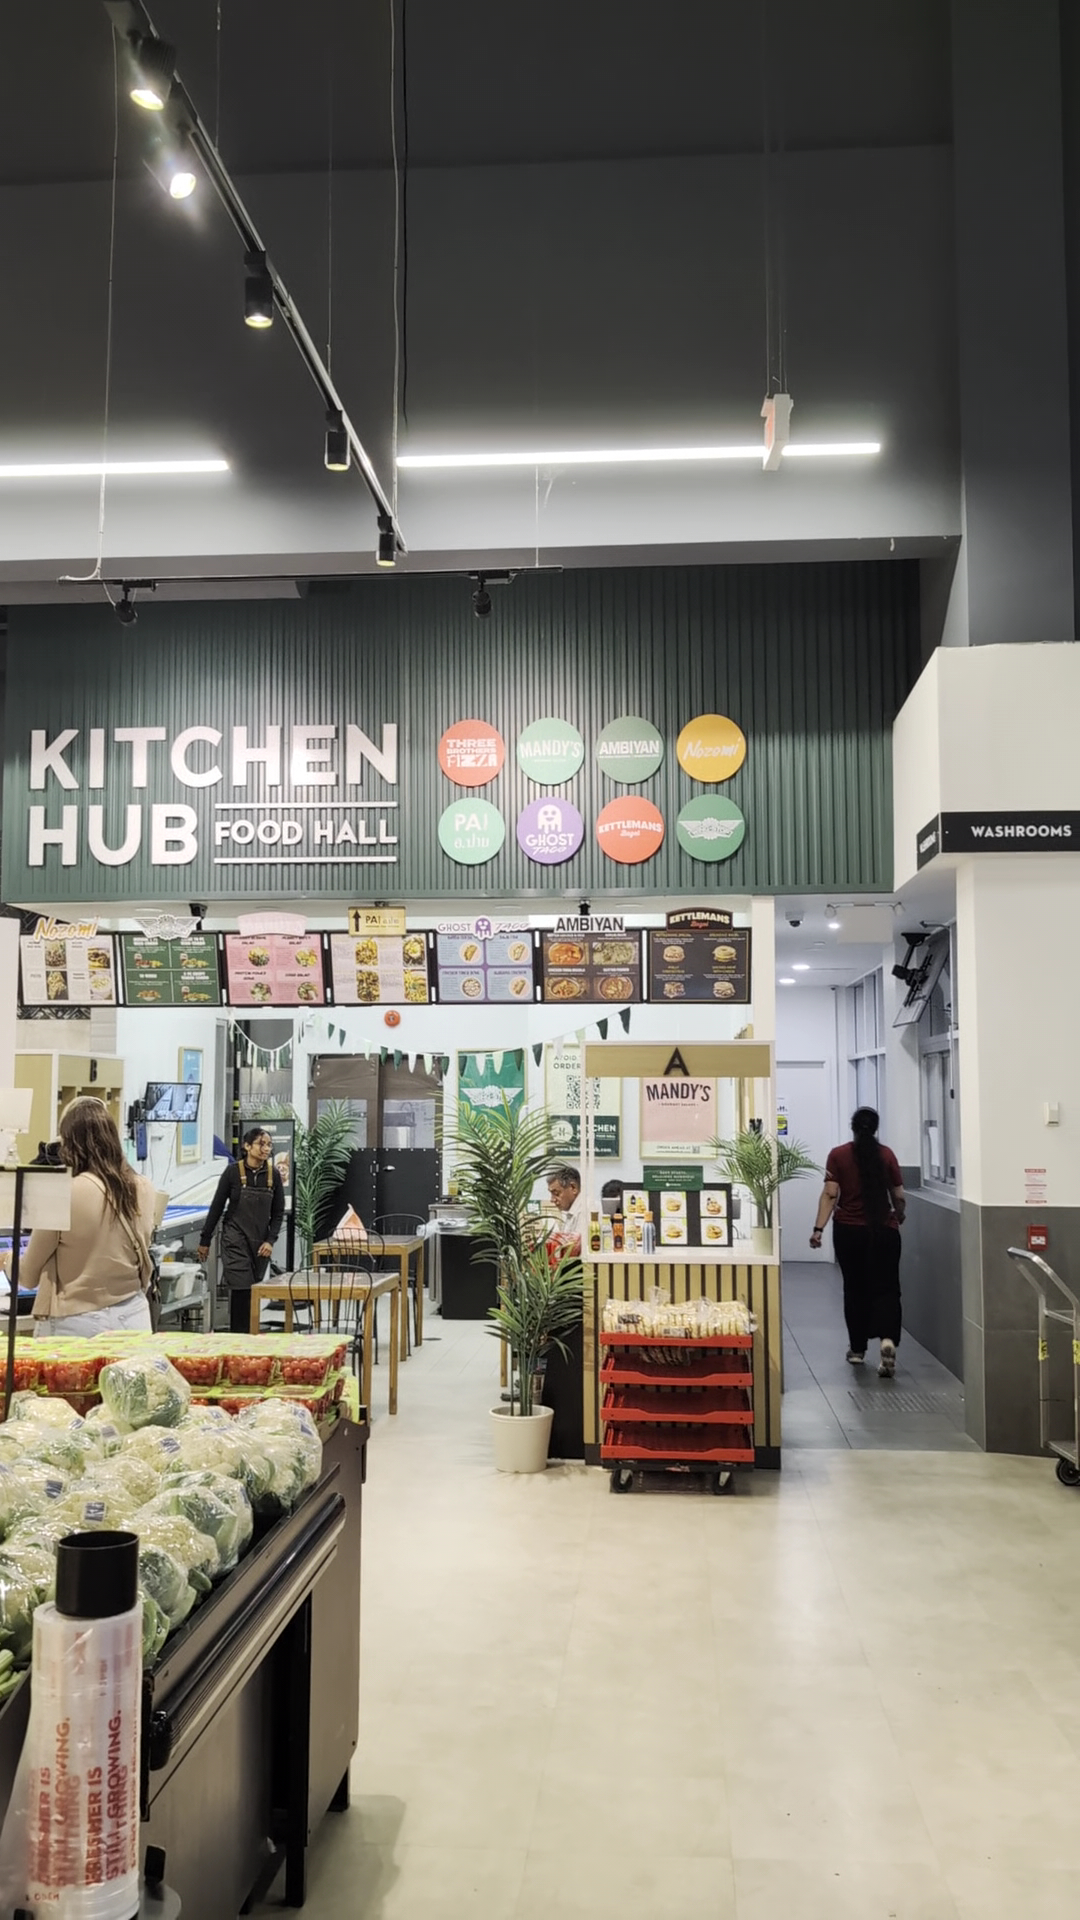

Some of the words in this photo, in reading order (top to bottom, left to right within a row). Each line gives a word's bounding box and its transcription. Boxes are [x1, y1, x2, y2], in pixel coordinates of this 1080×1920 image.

[446, 738, 496, 748] THREE
[520, 739, 580, 758] MANDY'S
[599, 740, 659, 755] AMBIYAN
[682, 736, 742, 761] Nozomi
[30, 723, 397, 789] KITCHEN
[454, 813, 488, 831] PAI
[598, 820, 662, 833] KETTLEMANS
[971, 825, 1072, 837] WASHROOMS
[28, 803, 198, 866] HUB
[214, 819, 303, 846] FOOD
[313, 818, 398, 845] HALL
[526, 833, 574, 846] GHOST
[556, 917, 624, 931] AMBIYAN
[669, 911, 730, 924] KETTLEMANS
[36, 916, 98, 940] Nozomi
[438, 923, 471, 932] GHOST
[663, 1047, 690, 1076] A
[646, 1083, 711, 1102] MANDY'S
[107, 1709, 121, 1819] GROWING.
[88, 1766, 103, 1785] IS
